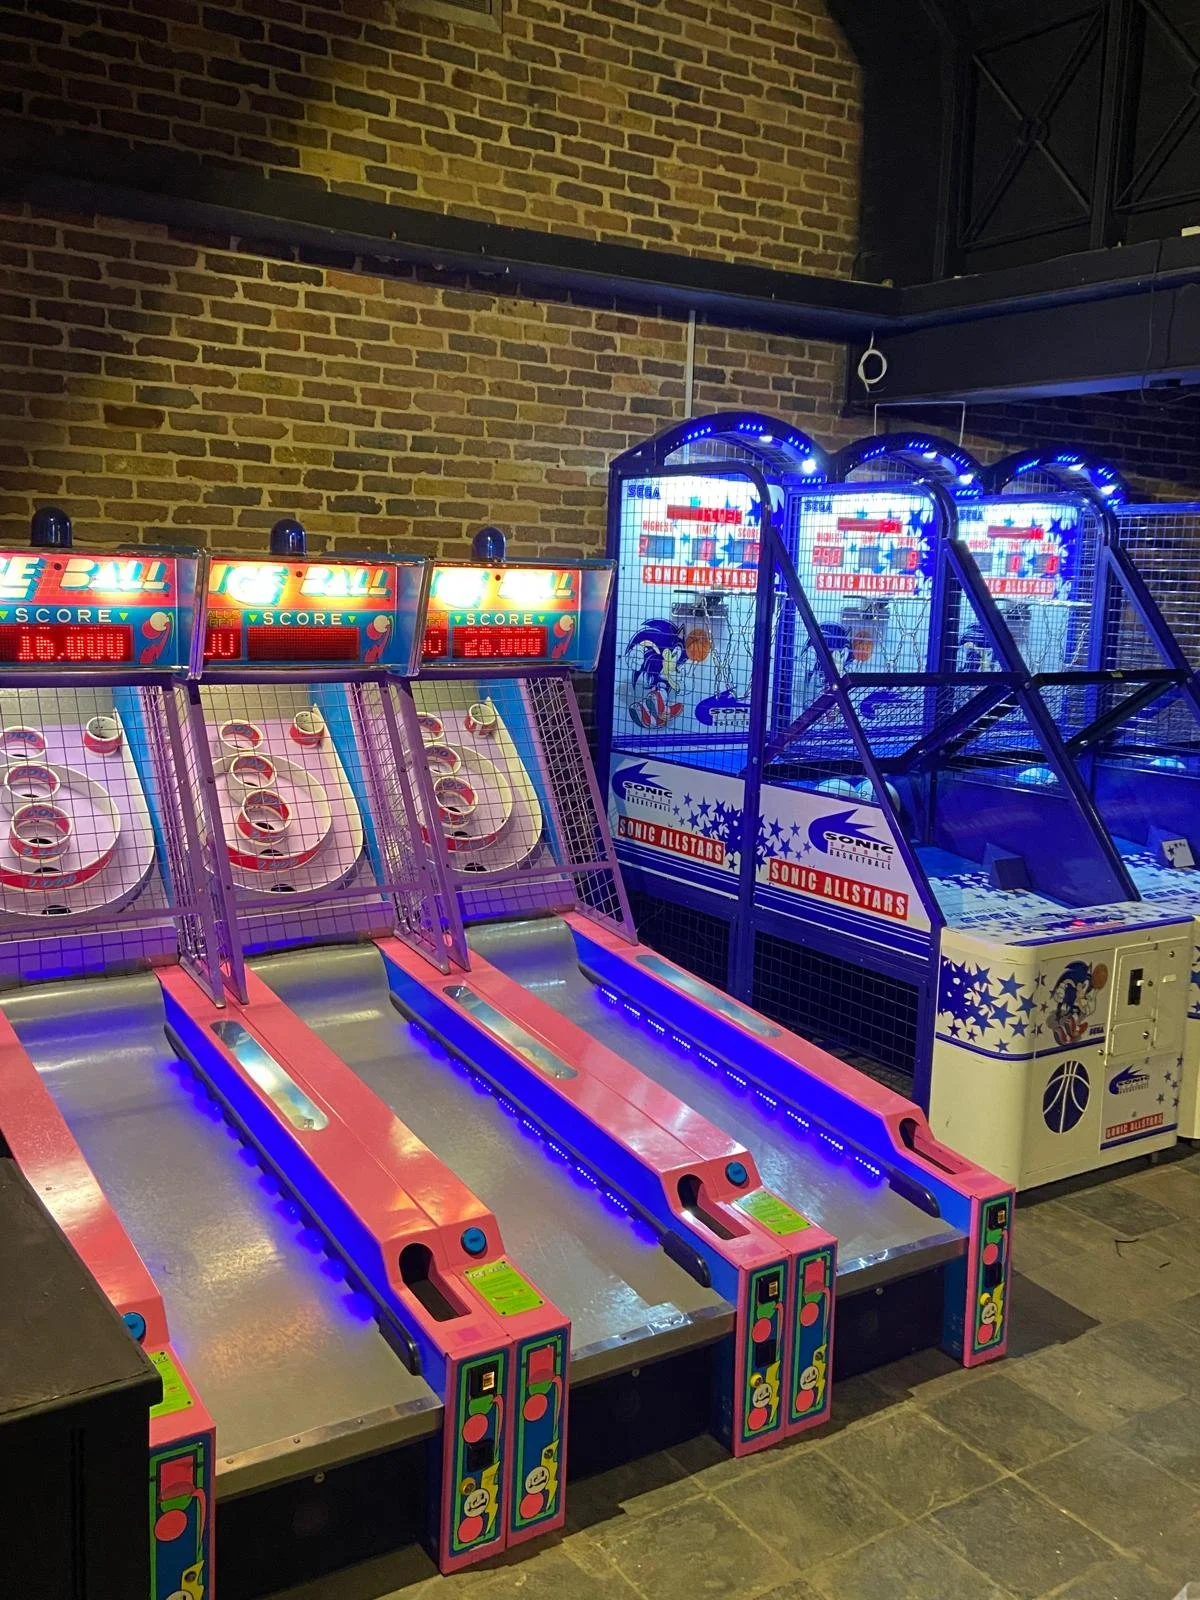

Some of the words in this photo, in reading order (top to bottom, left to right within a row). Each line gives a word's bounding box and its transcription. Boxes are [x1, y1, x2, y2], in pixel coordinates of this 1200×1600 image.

[628, 485, 661, 499] SEGA
[642, 520, 673, 532] HIGHEST
[696, 524, 712, 535] TIME
[59, 558, 171, 593] BALL
[299, 566, 391, 597] BALL
[644, 566, 688, 584] SONIC
[693, 569, 756, 586] ALLSTARS
[818, 574, 854, 588] SONIC
[859, 576, 913, 591] ALLSTARS
[1005, 580, 1051, 594] ALLSTARS
[15, 608, 112, 623] SCORE
[263, 612, 342, 626] SCORE
[466, 613, 534, 625] SCORE
[623, 782, 673, 799] SONIC
[620, 818, 656, 843] SONIC
[660, 830, 722, 862] ALLSTARS
[825, 832, 893, 854] SONIC
[830, 849, 891, 870] BASKETBALL
[771, 862, 817, 891] SONIC
[823, 876, 906, 916] ALLSTARS
[959, 911, 1022, 924] SEGA
[1106, 1123, 1129, 1138] SONIC
